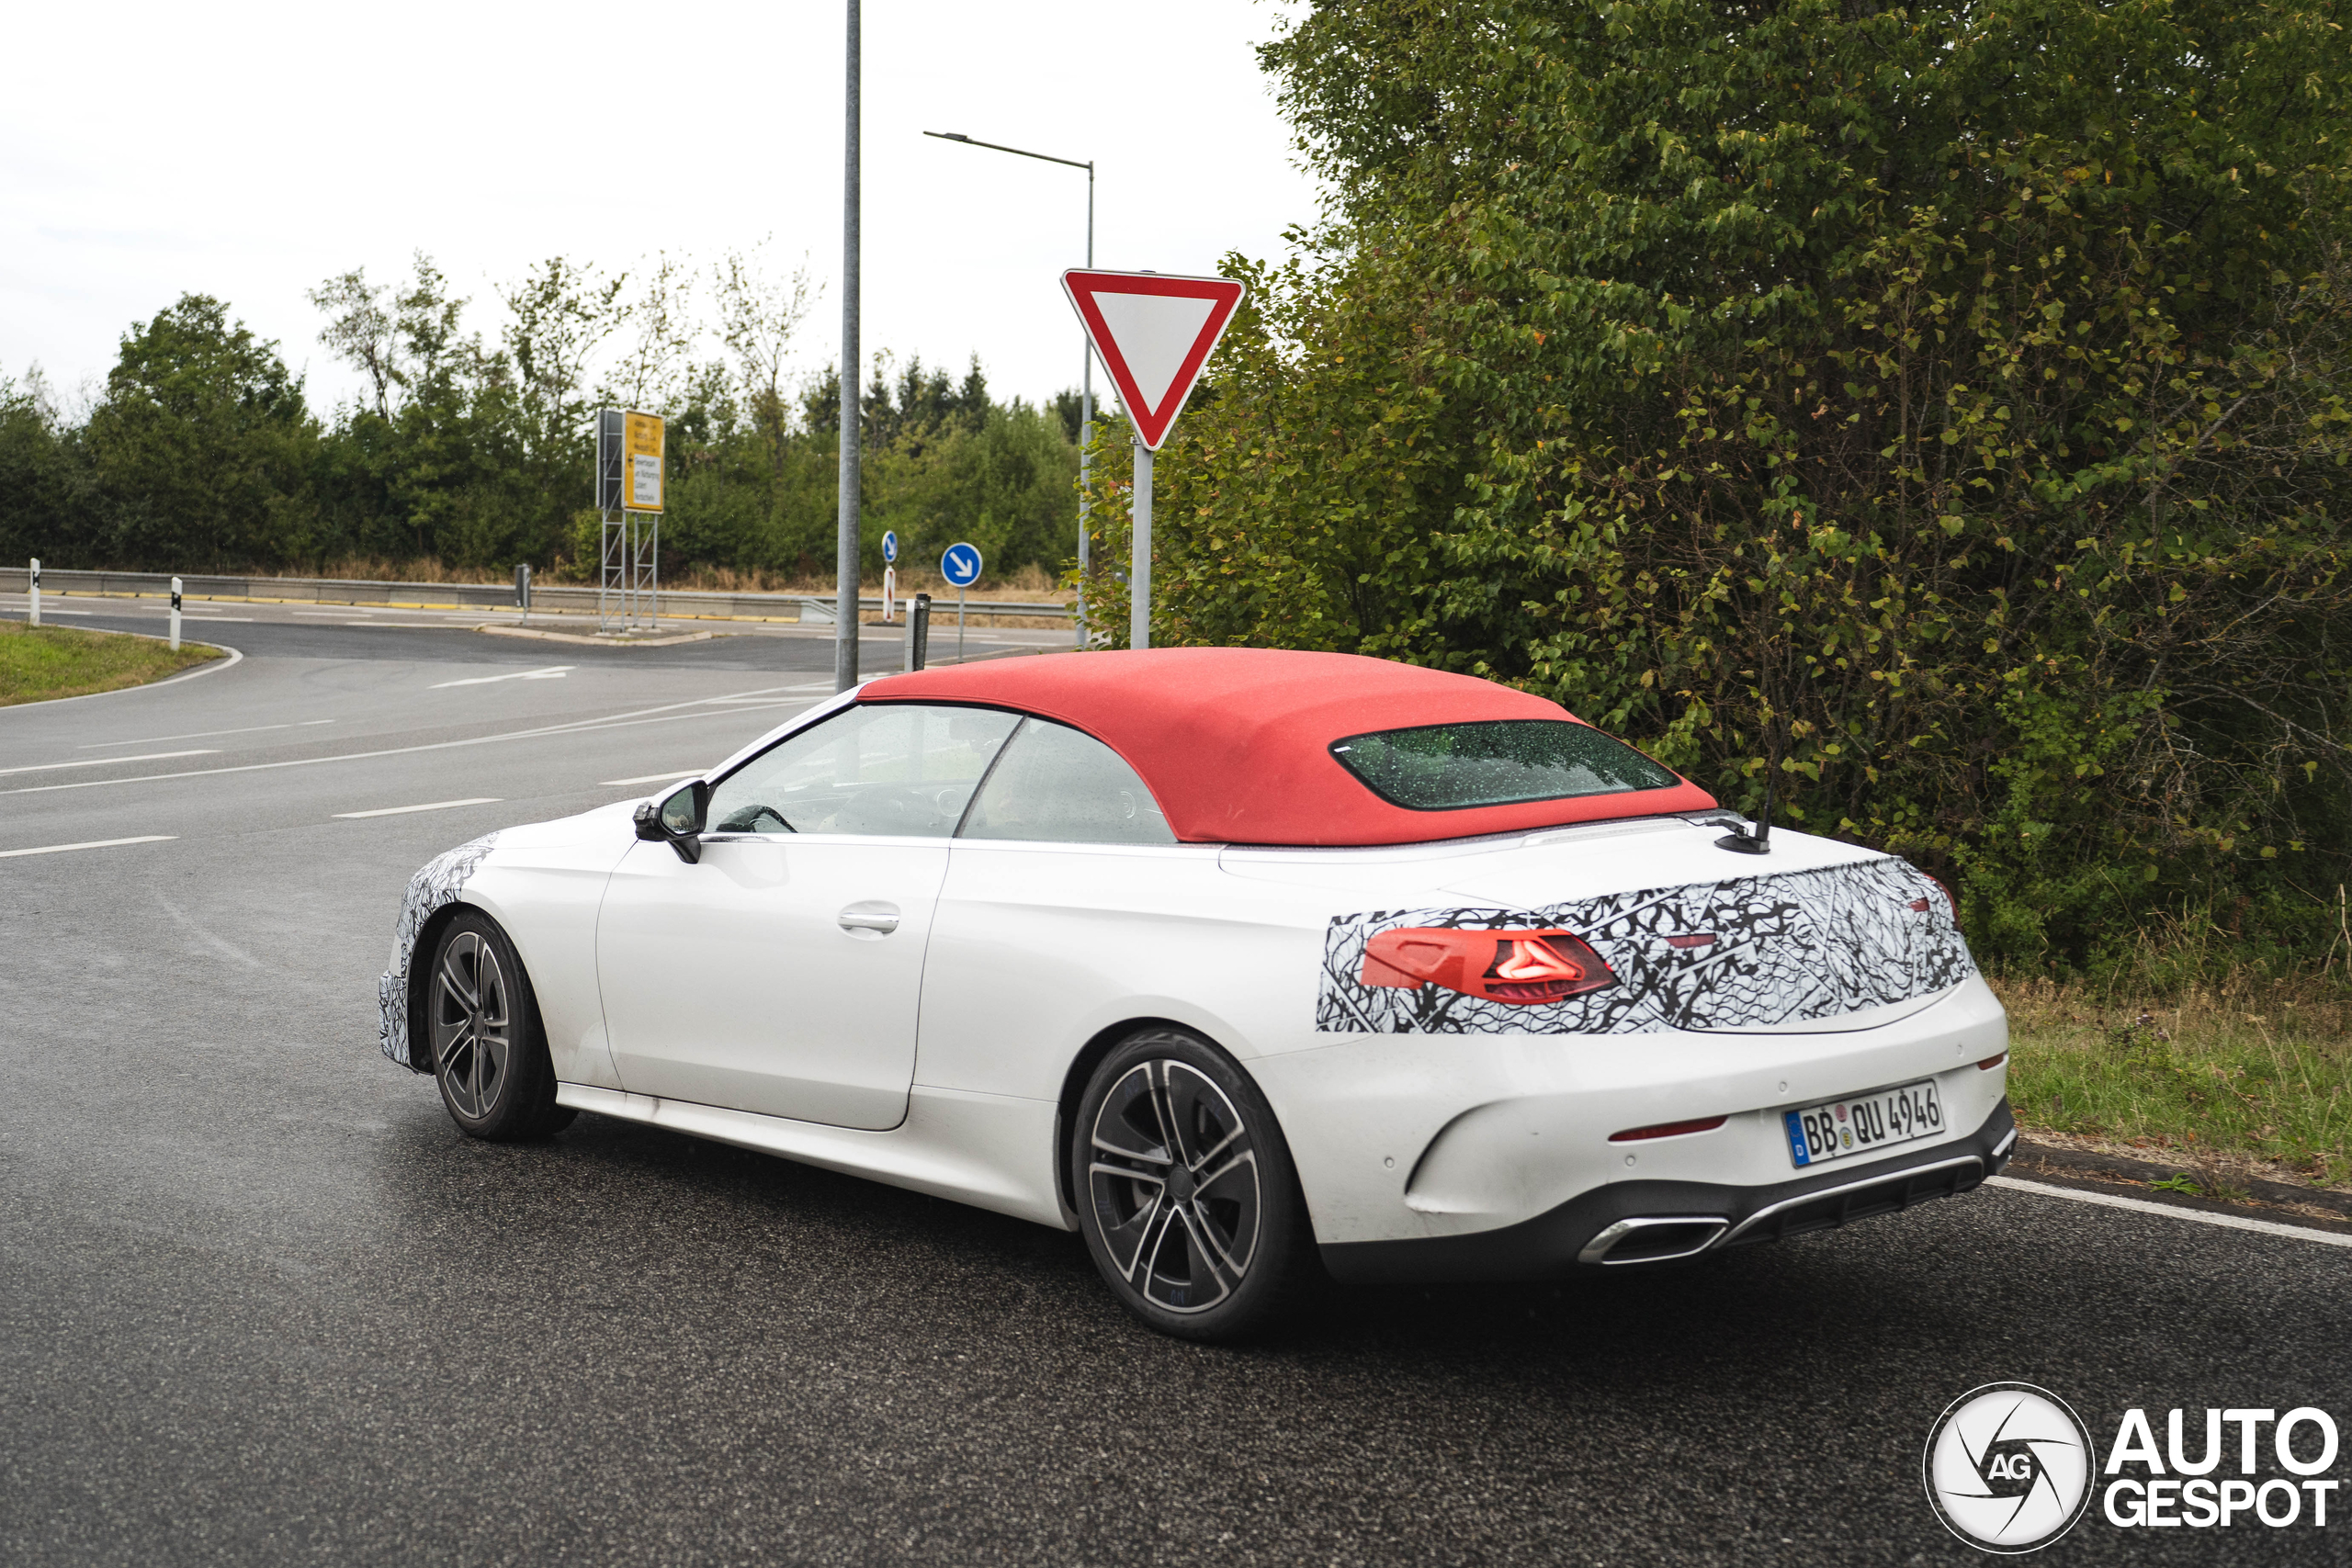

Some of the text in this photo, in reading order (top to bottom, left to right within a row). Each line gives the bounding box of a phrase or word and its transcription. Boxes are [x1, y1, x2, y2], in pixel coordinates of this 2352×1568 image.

[1804, 1089, 1939, 1156] BB QU 4946
[1796, 1145, 1803, 1156] D
